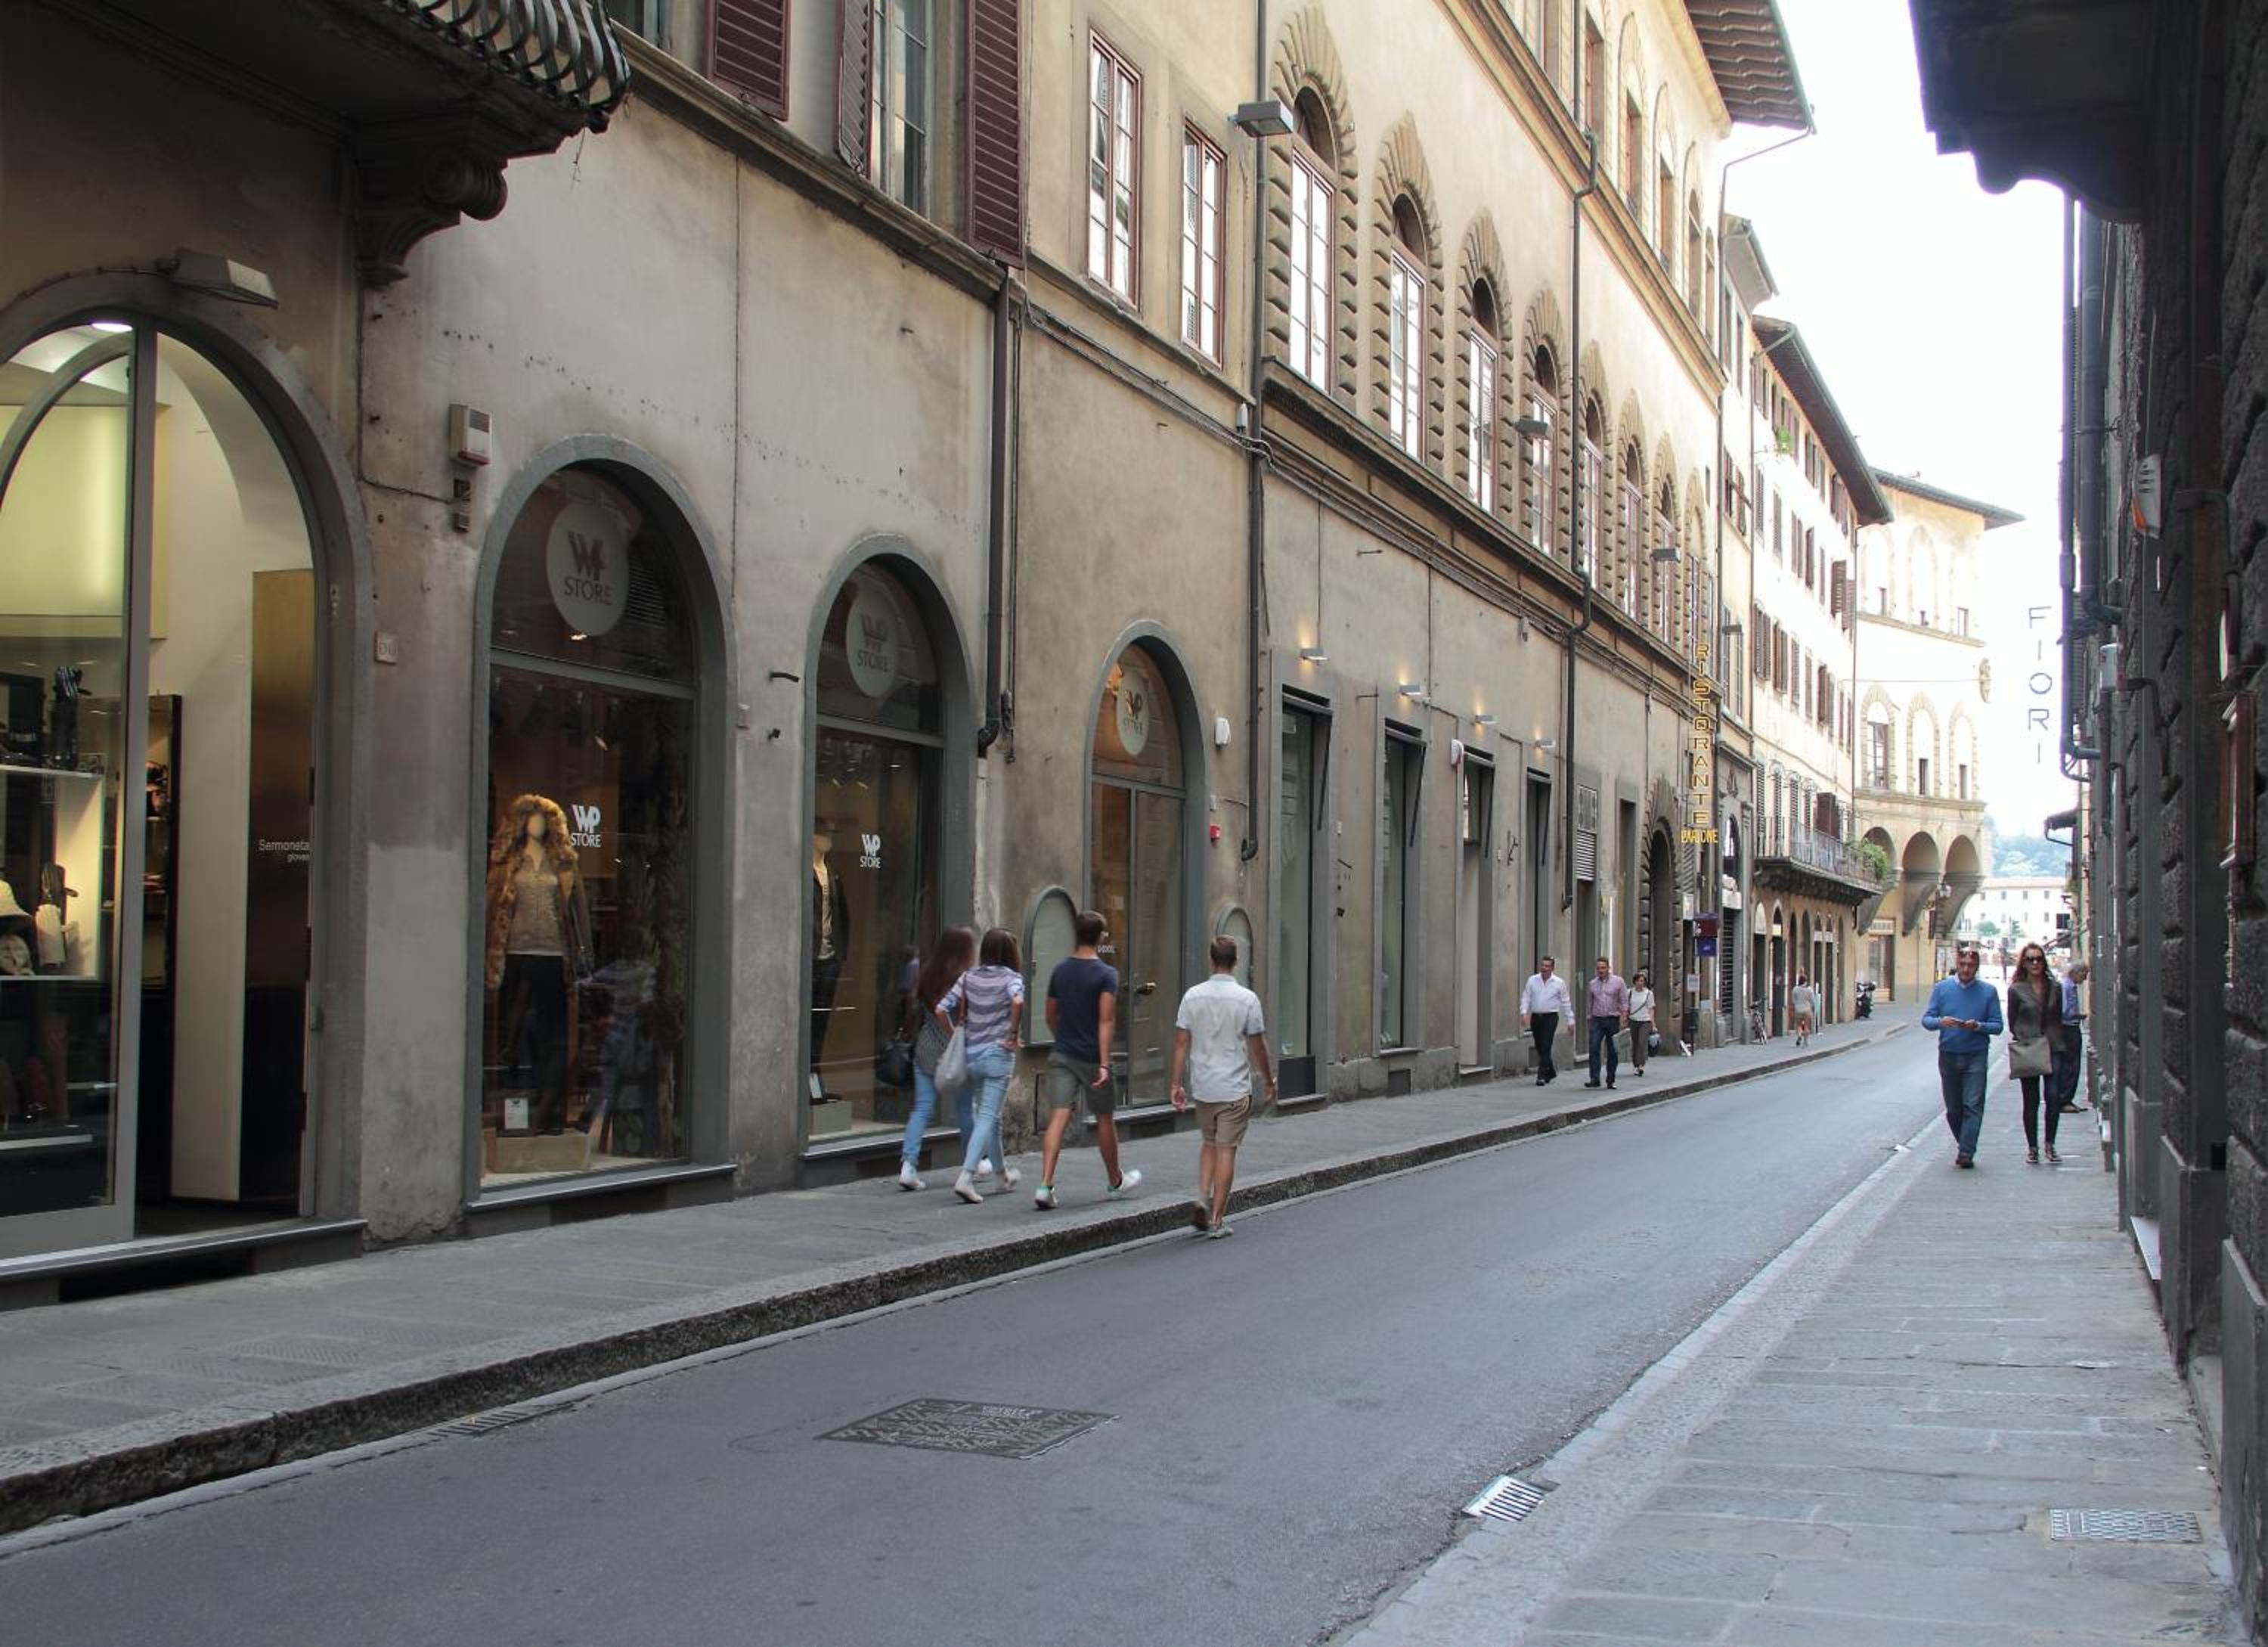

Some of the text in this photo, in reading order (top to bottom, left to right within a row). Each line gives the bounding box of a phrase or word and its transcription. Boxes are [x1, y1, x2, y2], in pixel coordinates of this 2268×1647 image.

[564, 575, 612, 606] STORE
[2028, 606, 2053, 764] FIORI
[1693, 643, 1712, 825] RISTORANTE
[572, 804, 601, 834] WP
[259, 839, 310, 851] Sermoneta
[571, 833, 601, 848] STORE
[861, 834, 881, 856] WP
[860, 855, 881, 869] STORE
